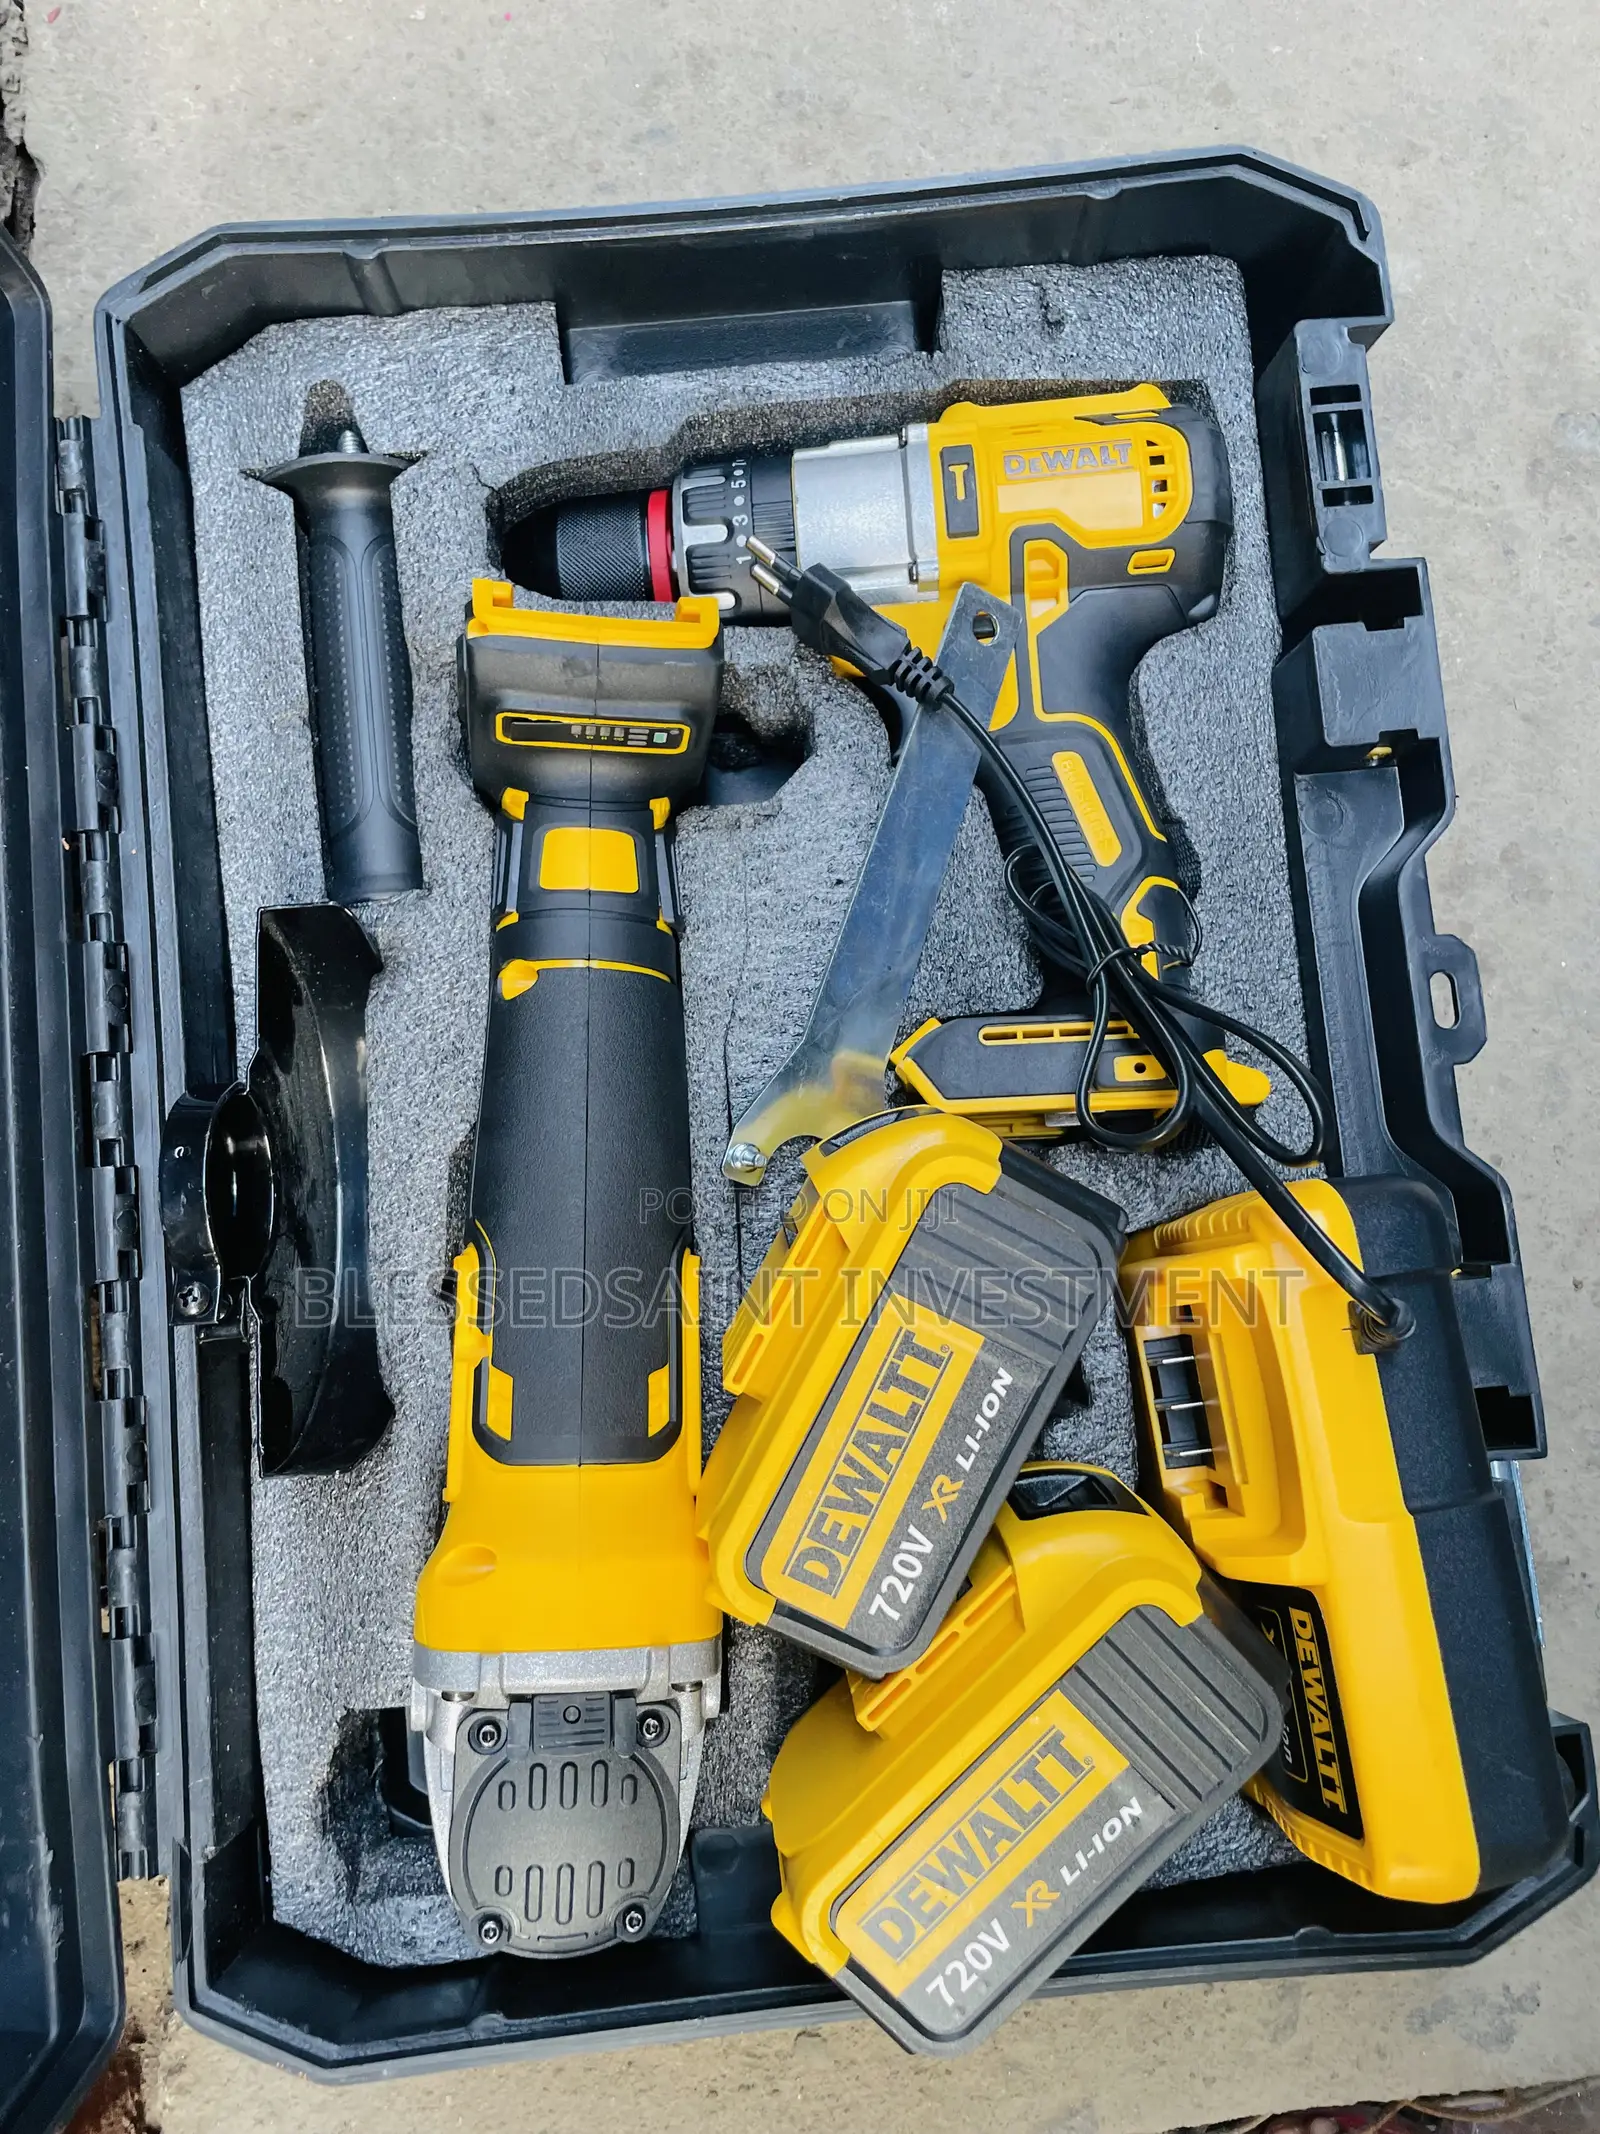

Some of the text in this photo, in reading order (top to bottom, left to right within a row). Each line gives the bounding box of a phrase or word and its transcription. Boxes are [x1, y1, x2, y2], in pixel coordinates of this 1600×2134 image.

[730, 480, 747, 489] 5
[1003, 443, 1132, 474] DEWALT
[732, 514, 748, 526] 3
[868, 1366, 1014, 1621] 720V XR LI-ION
[1290, 1608, 1348, 1814] DEWALTT
[925, 1796, 1143, 2006] 720V XR LI-ION
